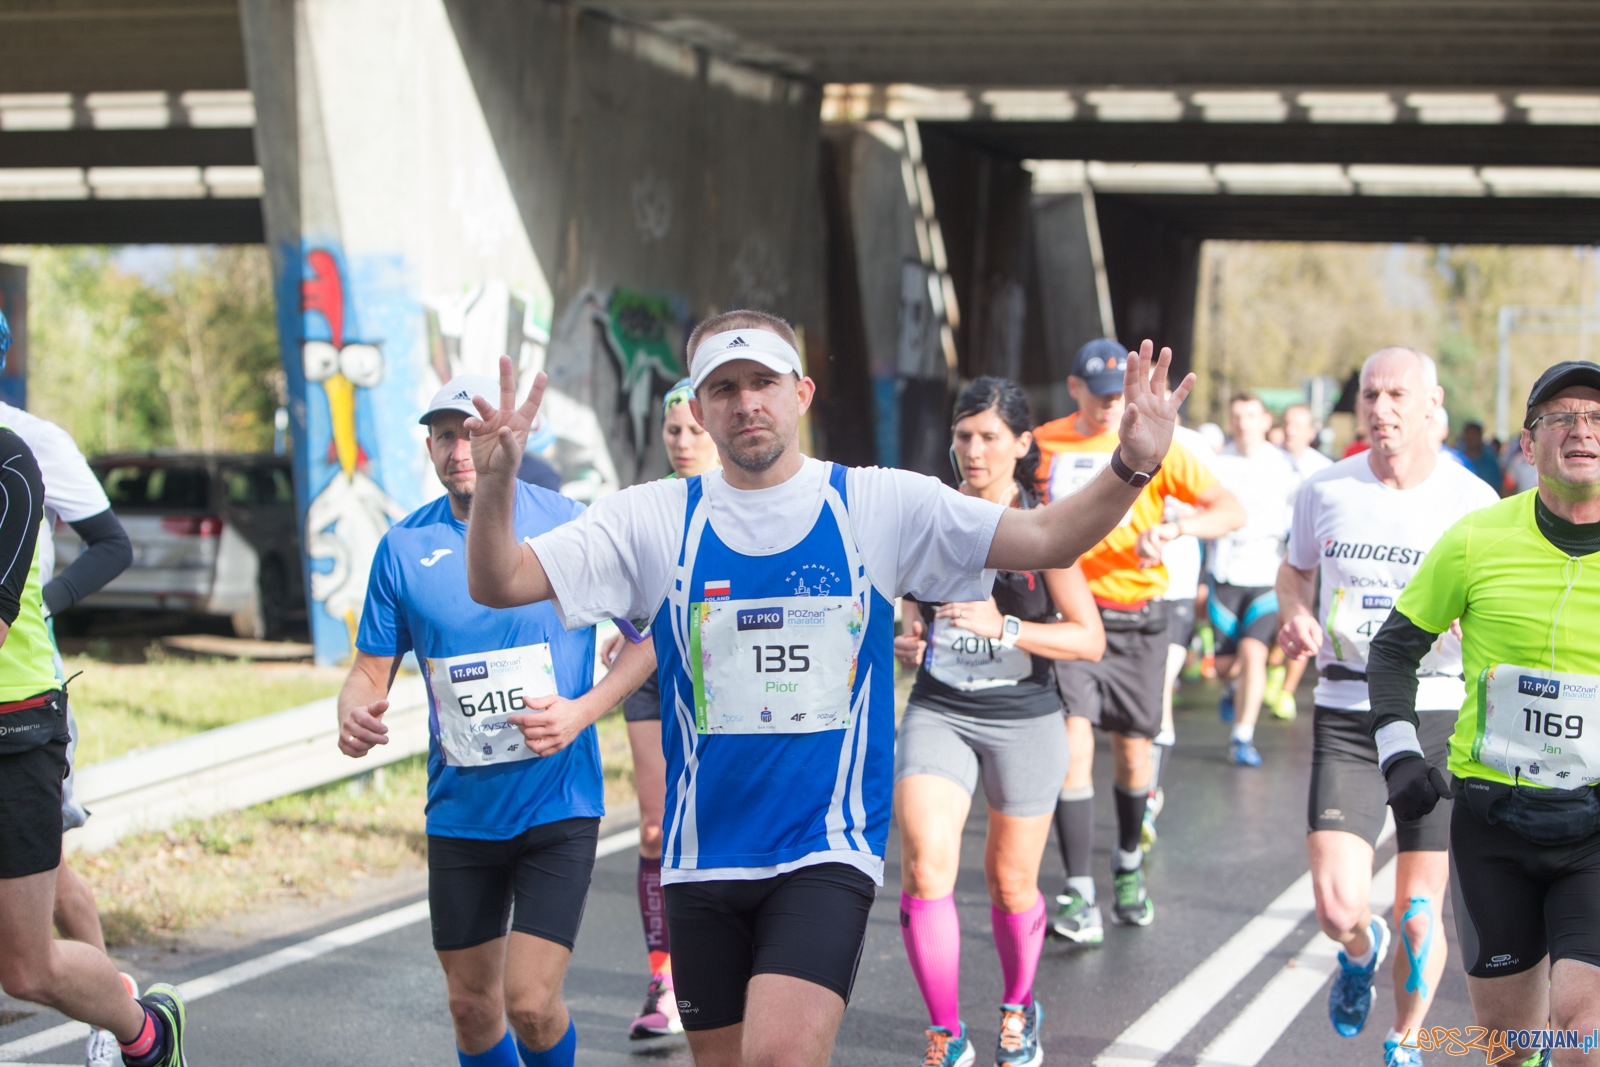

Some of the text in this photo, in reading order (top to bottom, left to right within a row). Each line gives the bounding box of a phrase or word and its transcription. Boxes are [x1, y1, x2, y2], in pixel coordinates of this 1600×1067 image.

[788, 617, 826, 625] maraton
[752, 645, 810, 673] 135
[765, 681, 798, 693] Piotr
[458, 687, 527, 717] 6416
[790, 713, 807, 722] 4F
[1523, 708, 1583, 739] 1169
[1540, 743, 1562, 755] Jan
[1556, 771, 1570, 779] 4F
[1486, 958, 1519, 968] Kalenji
